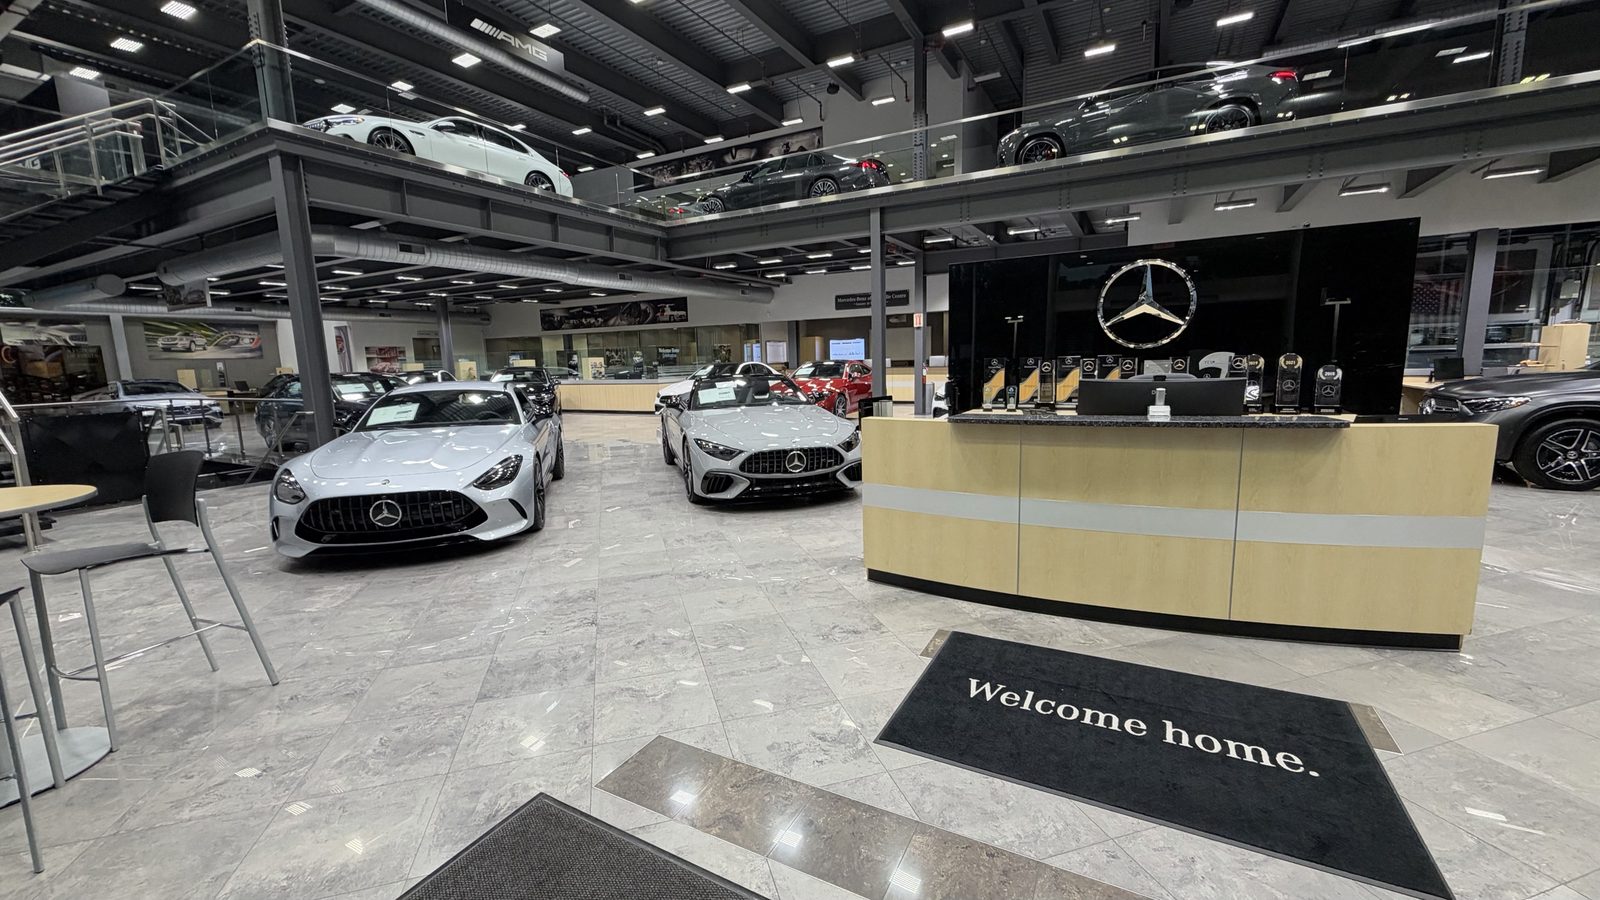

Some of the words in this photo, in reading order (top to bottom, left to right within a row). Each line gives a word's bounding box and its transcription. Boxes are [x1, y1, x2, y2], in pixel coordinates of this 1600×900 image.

[497, 31, 548, 62] AMG
[968, 677, 1148, 737] Welcome
[1162, 719, 1321, 778] home.
